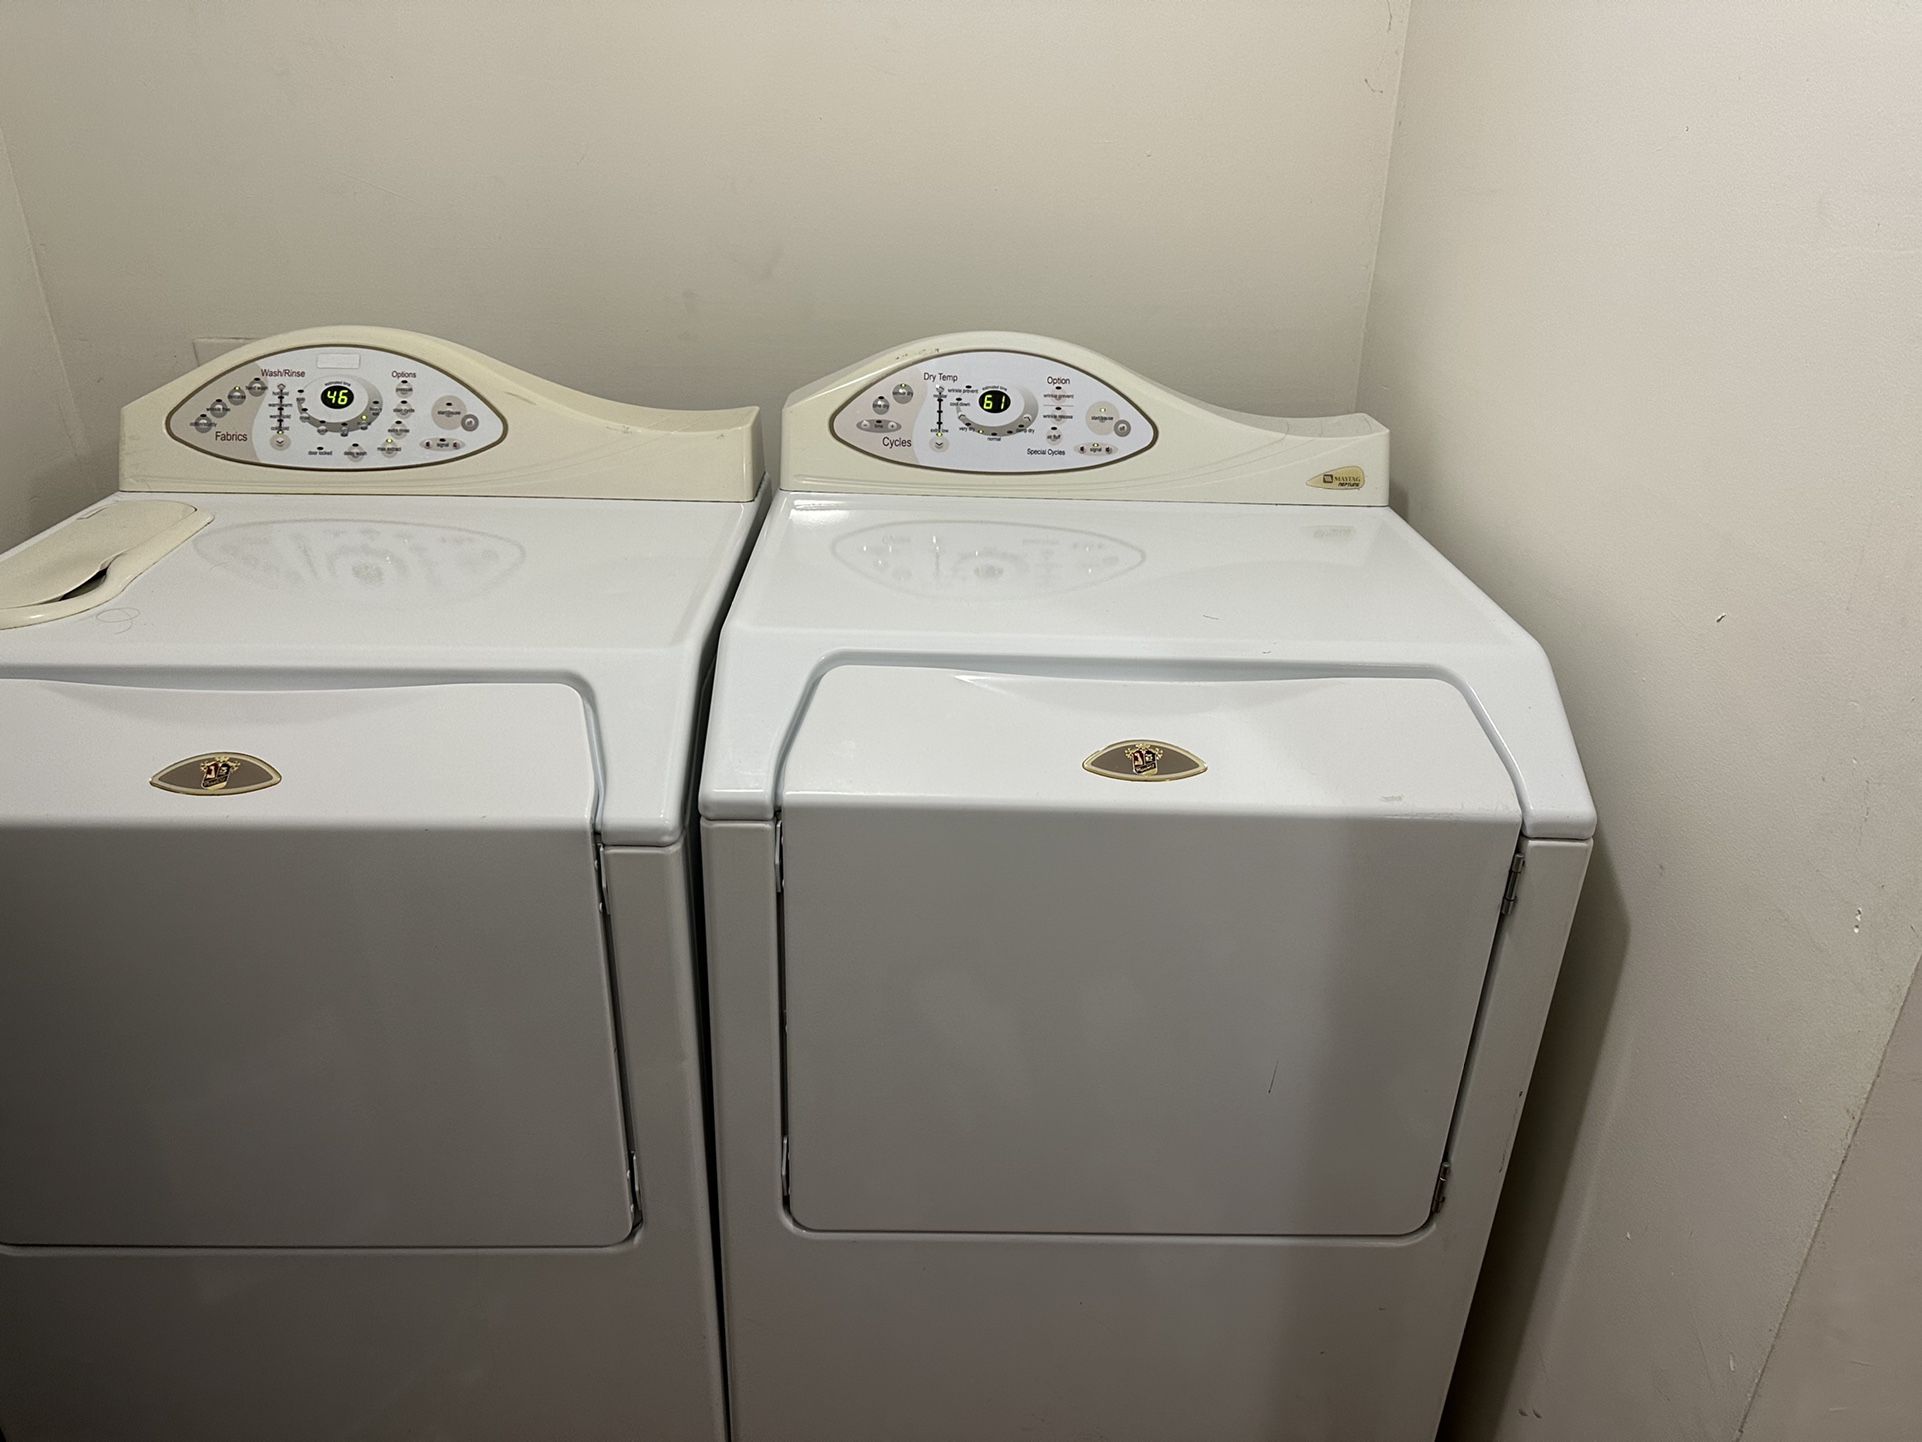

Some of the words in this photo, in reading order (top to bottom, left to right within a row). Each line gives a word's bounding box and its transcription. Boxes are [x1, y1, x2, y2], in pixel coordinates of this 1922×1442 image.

[261, 368, 305, 378] Wash/Rinse
[391, 371, 417, 380] Options
[923, 372, 936, 382] Dry
[939, 372, 958, 383] Temp
[1047, 376, 1071, 386] Option
[326, 389, 349, 405] 46
[983, 394, 1006, 410] 61
[214, 431, 248, 442] Fabrics
[882, 436, 912, 449] Cycles
[1026, 448, 1047, 457] Special
[1047, 448, 1066, 457] Cycles
